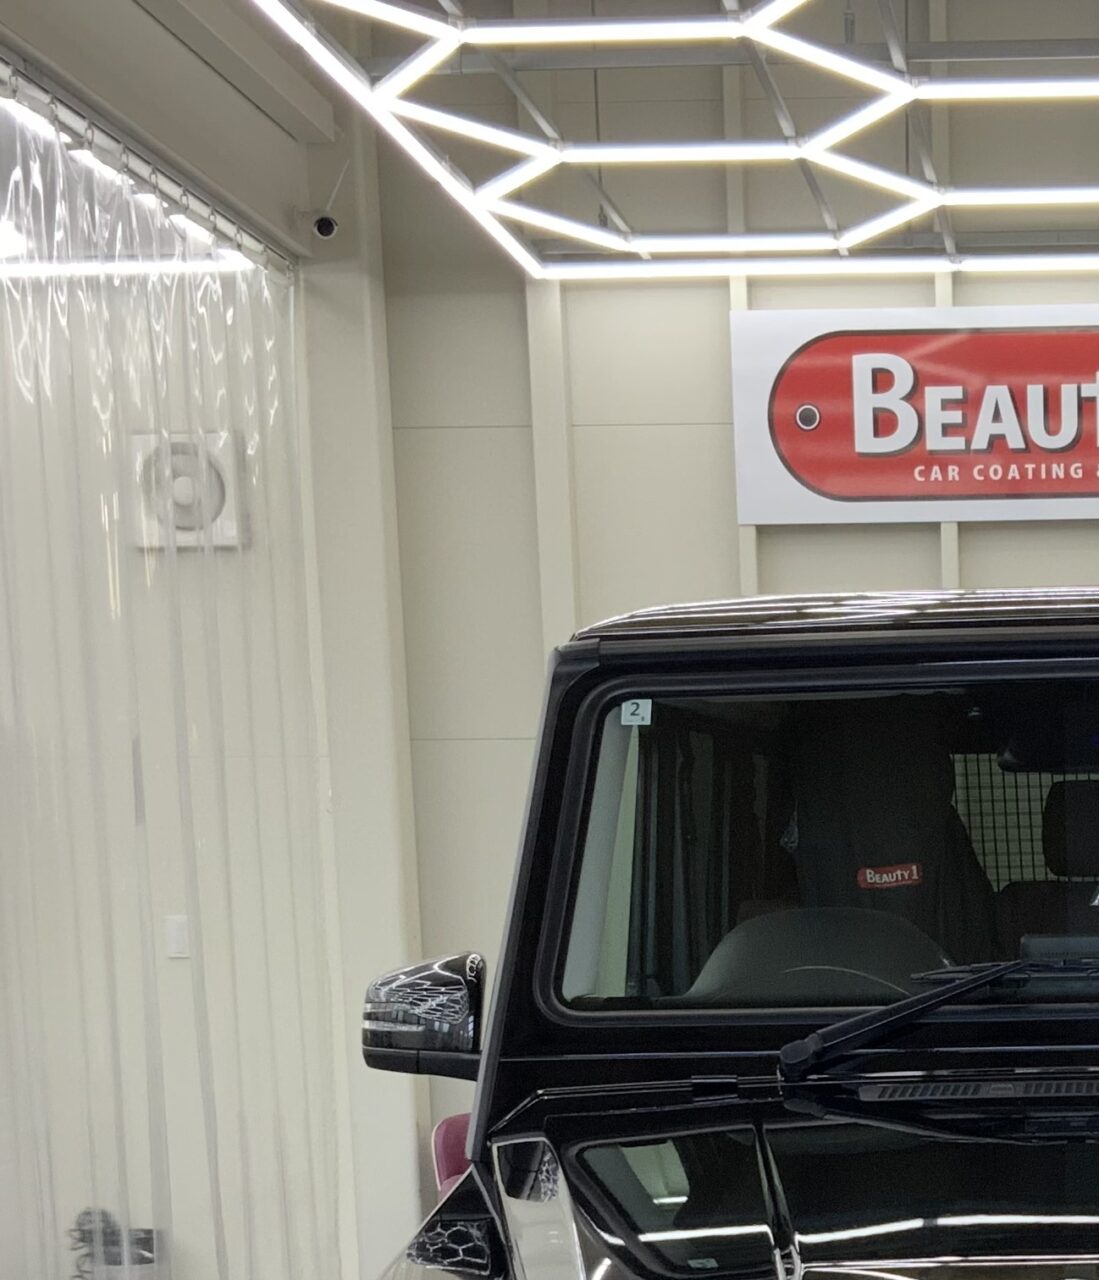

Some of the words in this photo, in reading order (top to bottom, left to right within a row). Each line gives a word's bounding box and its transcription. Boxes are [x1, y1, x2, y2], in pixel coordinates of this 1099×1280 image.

[913, 464, 960, 482] CAR
[972, 462, 1084, 481] COATING
[630, 702, 641, 717] 2
